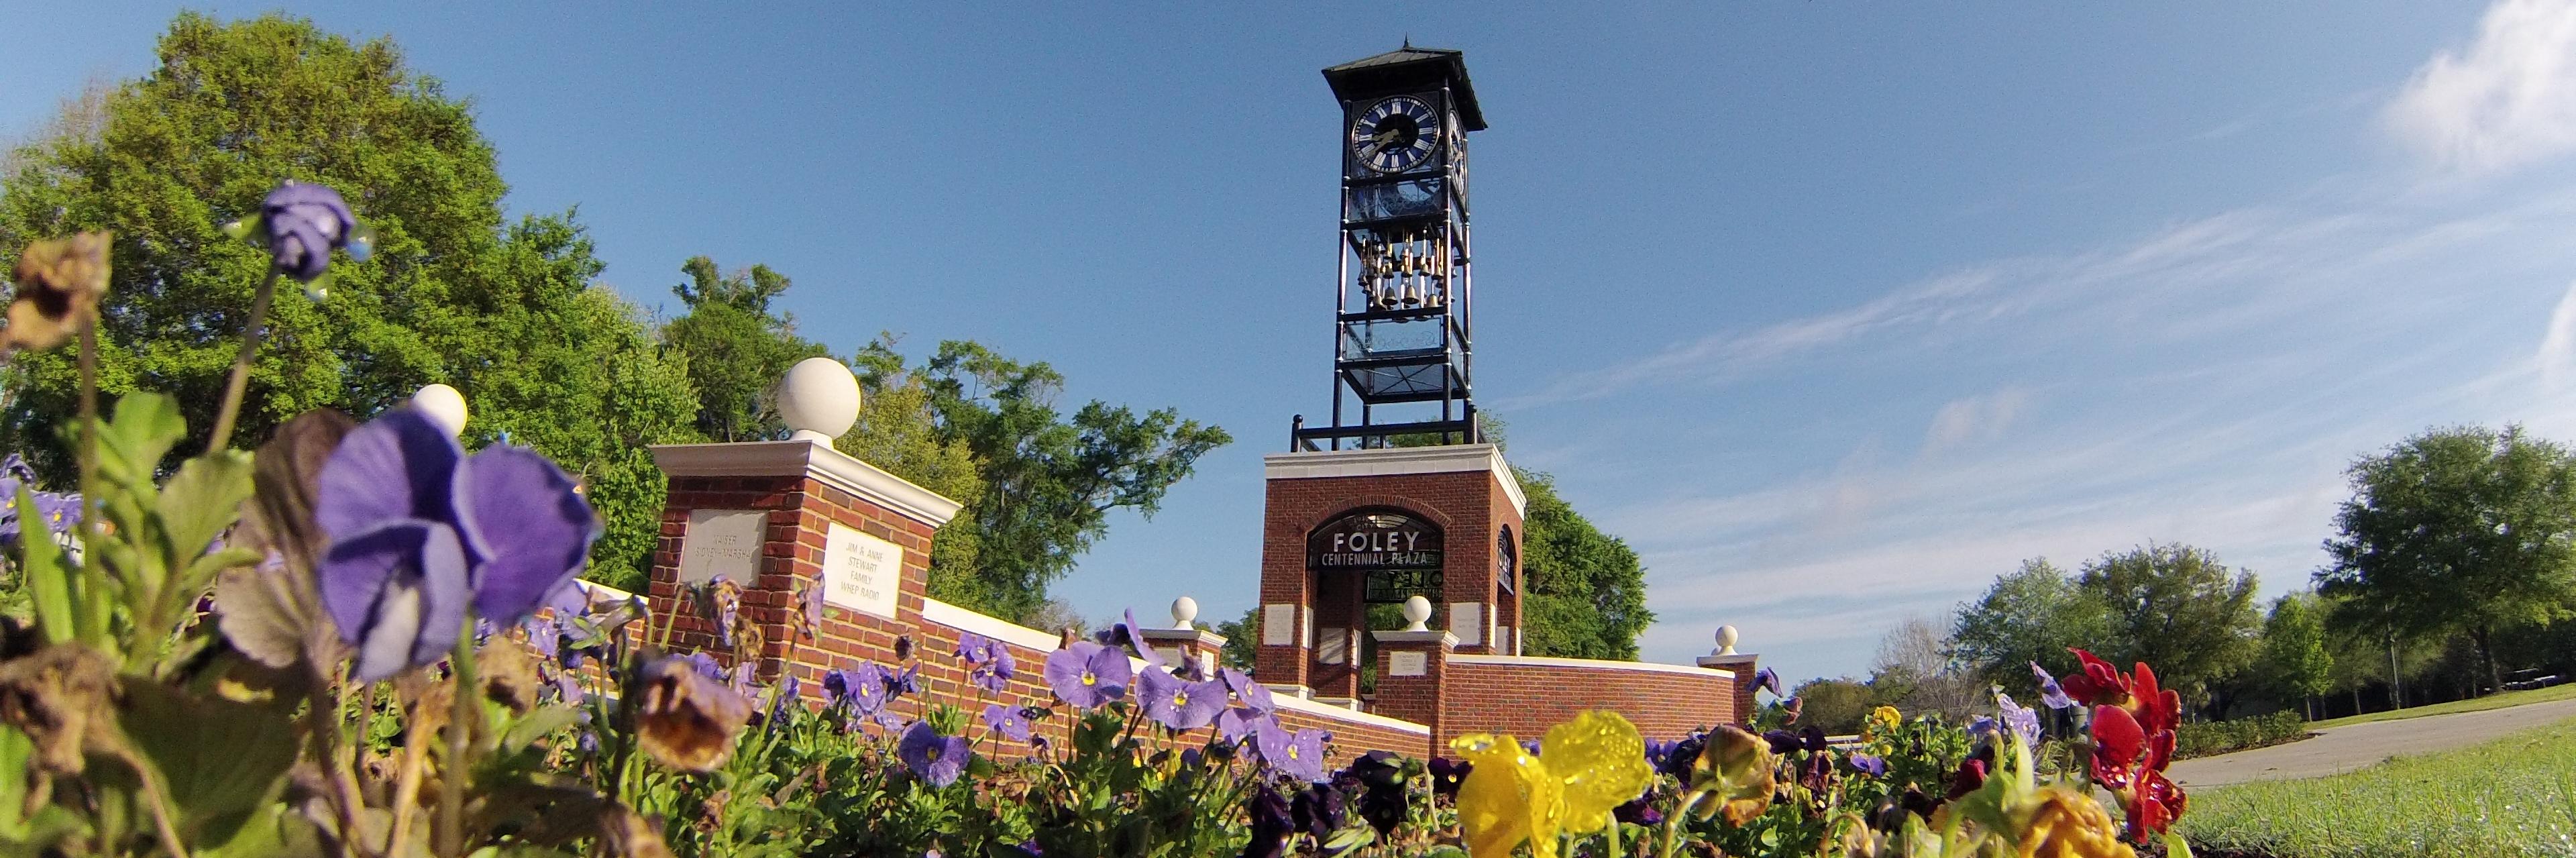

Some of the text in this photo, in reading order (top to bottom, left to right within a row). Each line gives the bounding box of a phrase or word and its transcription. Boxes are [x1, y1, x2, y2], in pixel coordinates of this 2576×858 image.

[713, 535, 737, 545] KAISER
[1333, 531, 1420, 552] FOLEY
[845, 542, 883, 562] JIM & ANNE
[1322, 551, 1428, 566] CENTENNIAL PLAZA
[848, 556, 878, 573] STEWART
[851, 570, 873, 585] FAMILY
[841, 581, 879, 601] WHEP RADIO
